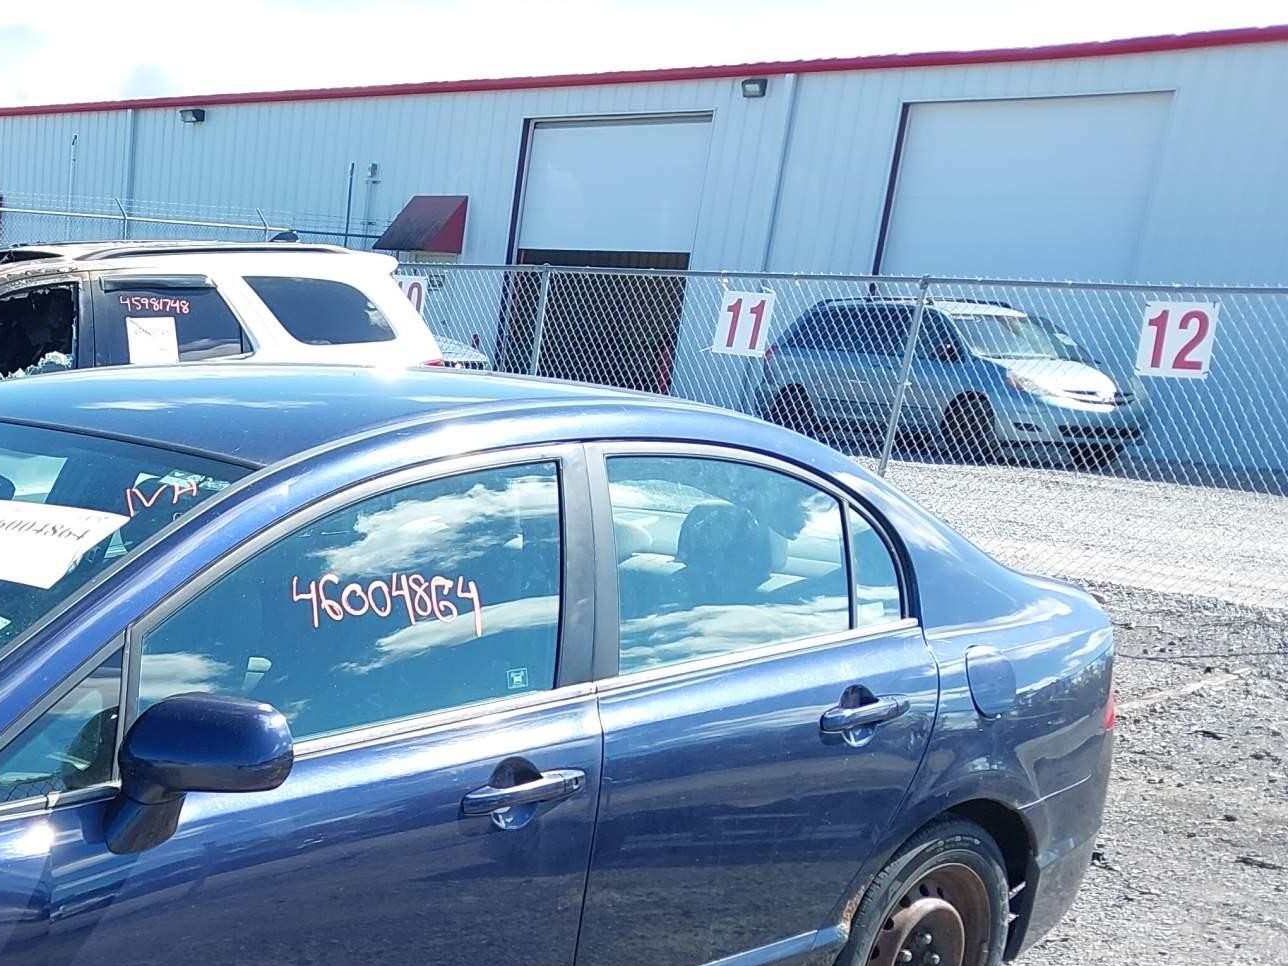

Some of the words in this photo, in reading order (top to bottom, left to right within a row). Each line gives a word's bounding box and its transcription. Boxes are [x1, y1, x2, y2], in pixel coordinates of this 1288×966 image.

[120, 296, 190, 314] 45981748
[726, 298, 767, 350] 11
[1148, 309, 1210, 371] 12
[292, 572, 483, 638] 46004864
